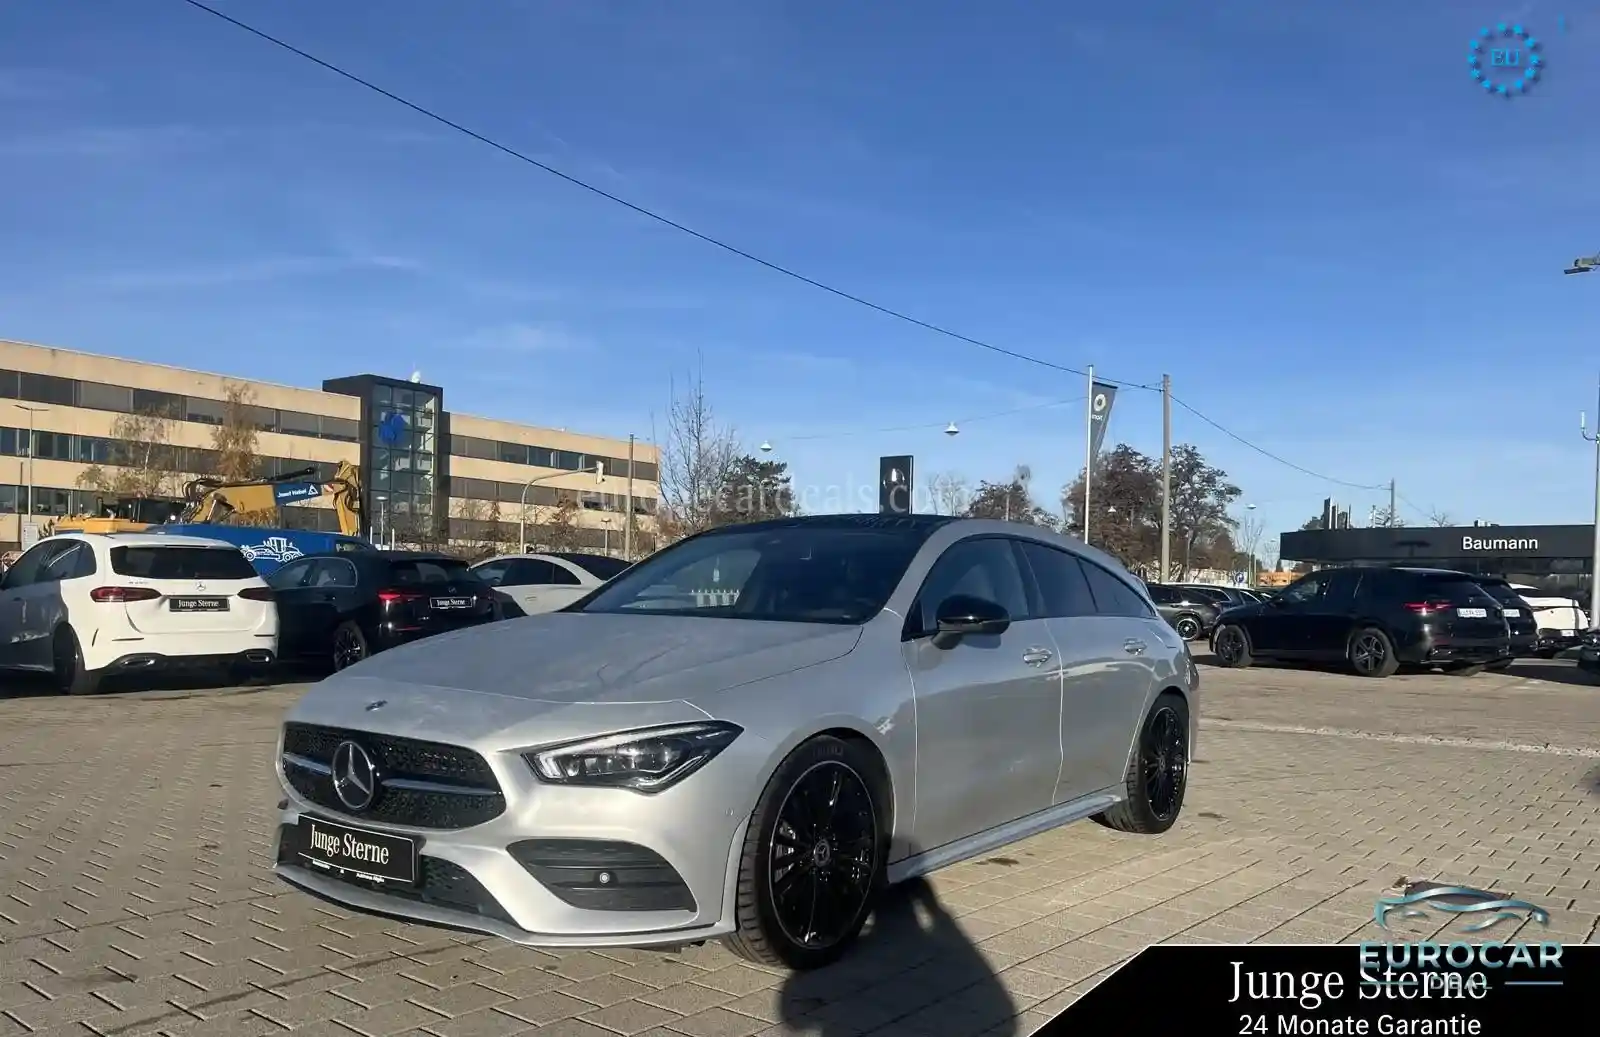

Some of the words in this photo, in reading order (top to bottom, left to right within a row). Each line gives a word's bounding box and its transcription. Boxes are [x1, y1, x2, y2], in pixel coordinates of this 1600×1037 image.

[1462, 536, 1538, 550] Baumann
[178, 599, 197, 608] Junge
[198, 599, 219, 607] Sterne
[310, 823, 341, 858] Junge
[342, 832, 390, 865] Sterne
